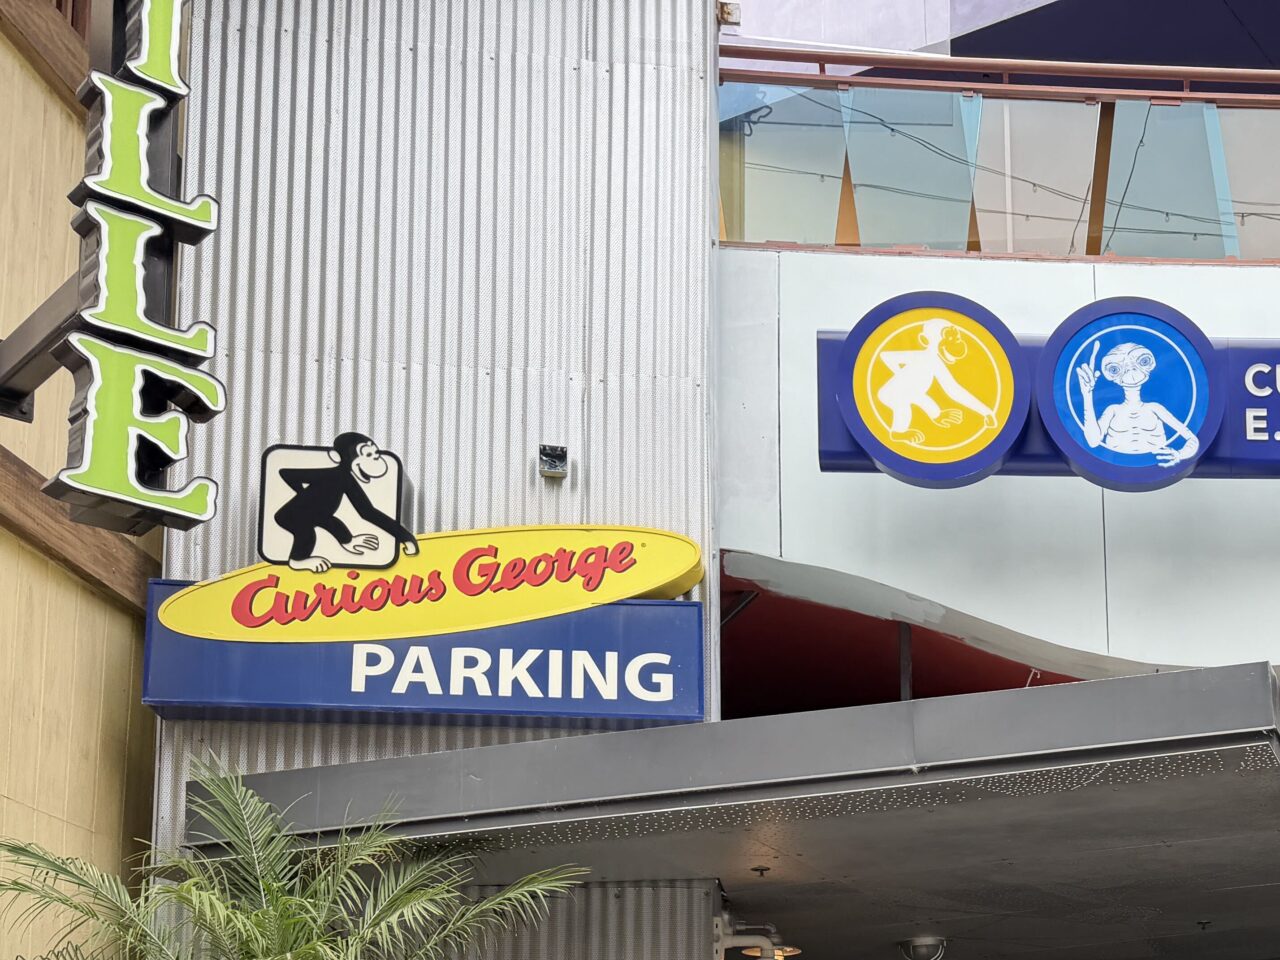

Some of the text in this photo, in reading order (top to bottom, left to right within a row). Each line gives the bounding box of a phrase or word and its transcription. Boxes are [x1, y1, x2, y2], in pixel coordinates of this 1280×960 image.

[230, 540, 637, 629] Curious George
[350, 643, 675, 702] PARKING
